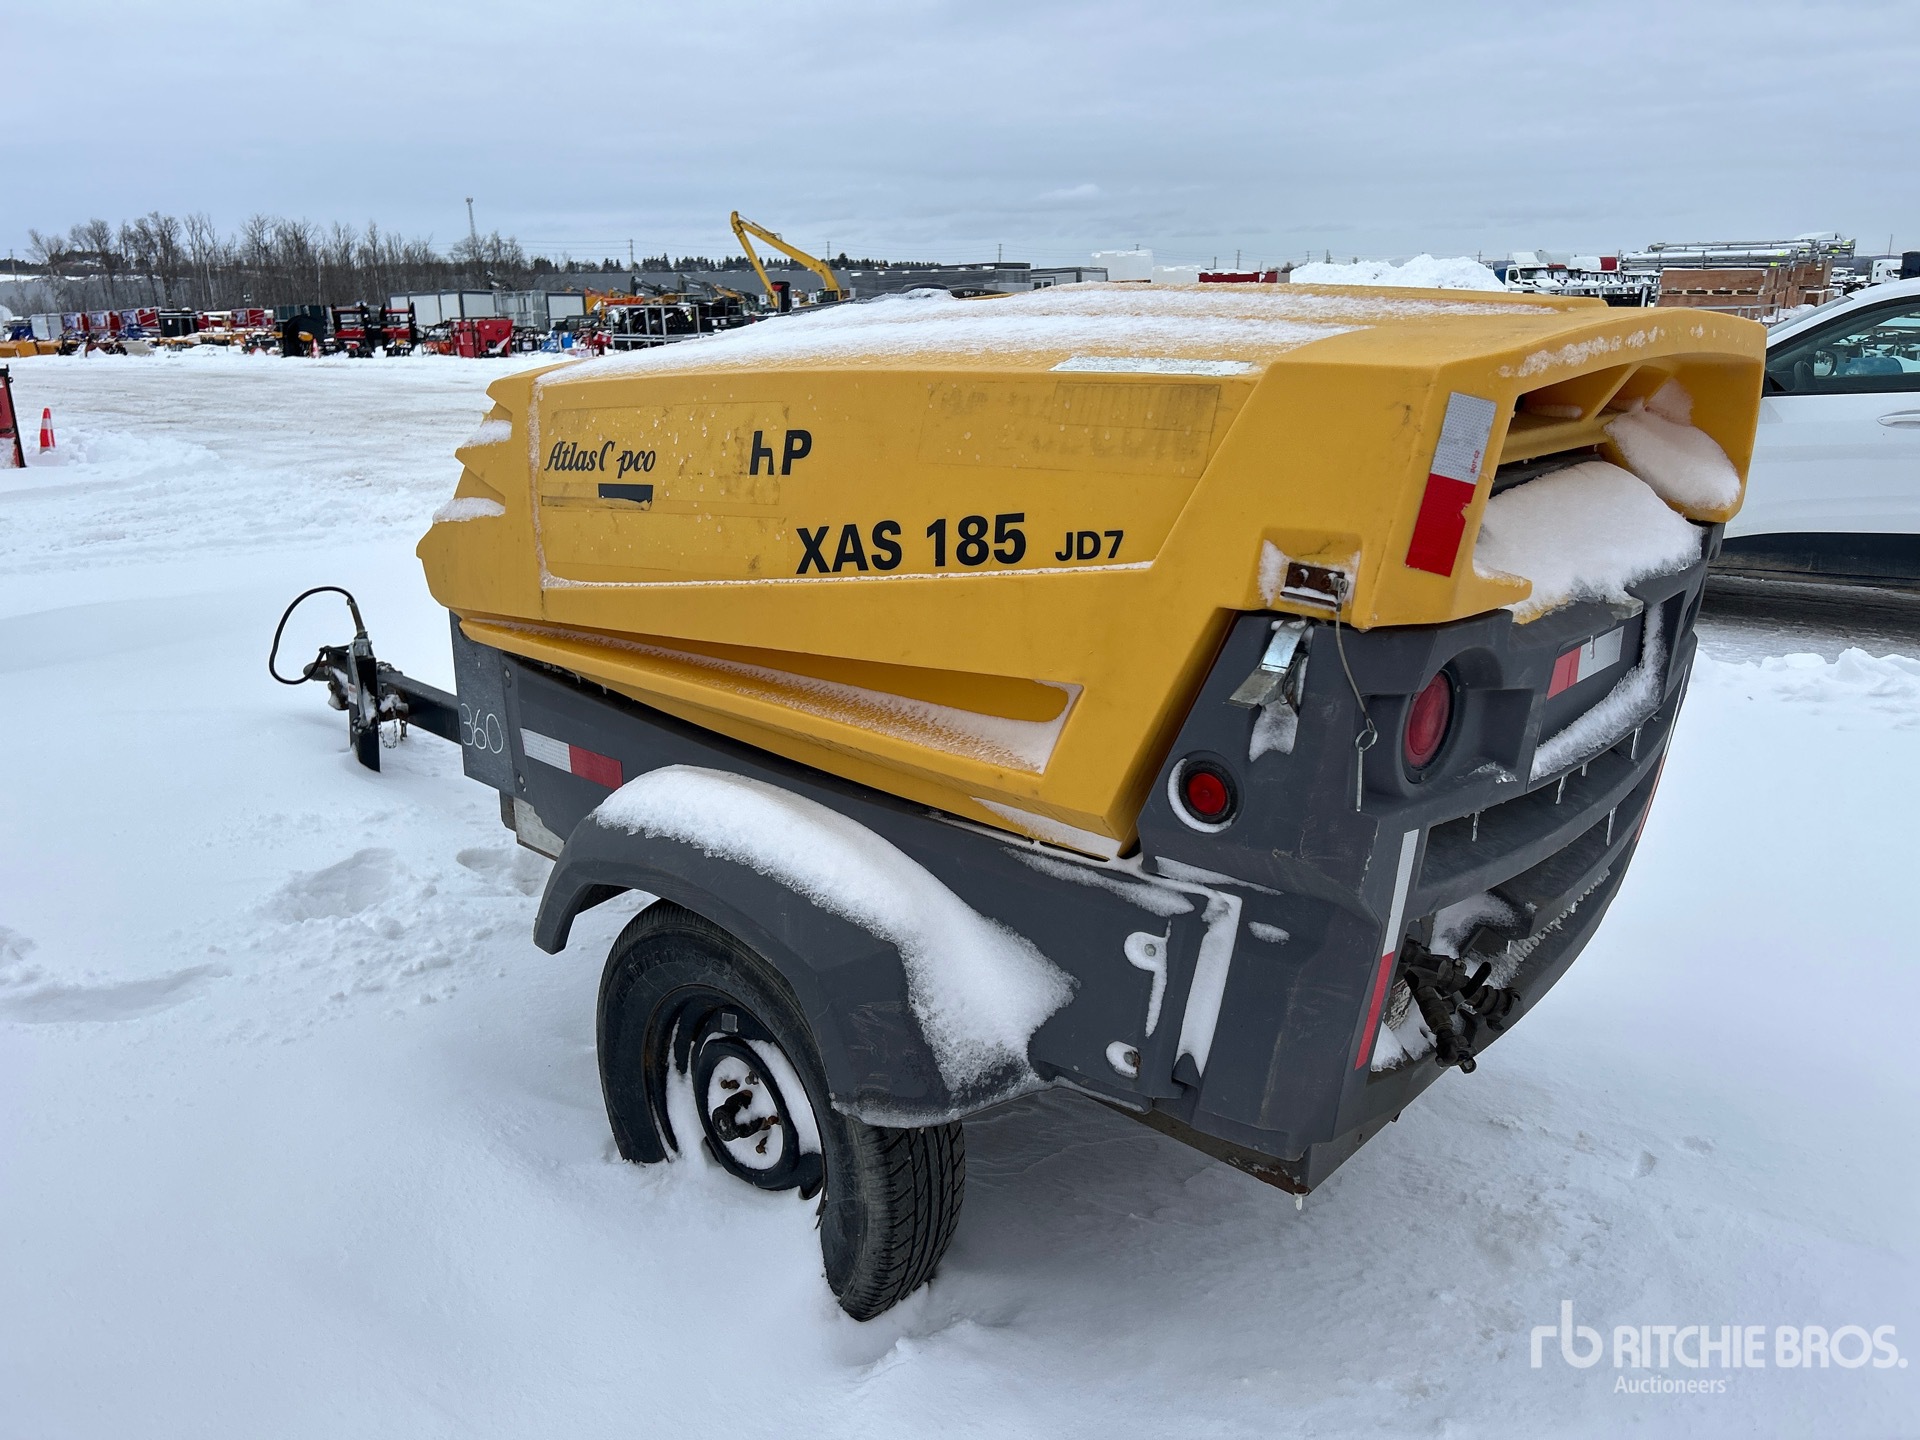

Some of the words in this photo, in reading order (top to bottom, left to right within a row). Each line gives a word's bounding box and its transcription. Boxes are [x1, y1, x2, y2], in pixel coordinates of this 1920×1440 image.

[544, 441, 598, 471] Atlas
[599, 440, 656, 479] Cpco
[796, 520, 902, 574] XAS
[926, 512, 1027, 567] 185
[1055, 530, 1124, 561] JD7
[461, 703, 504, 754] 360
